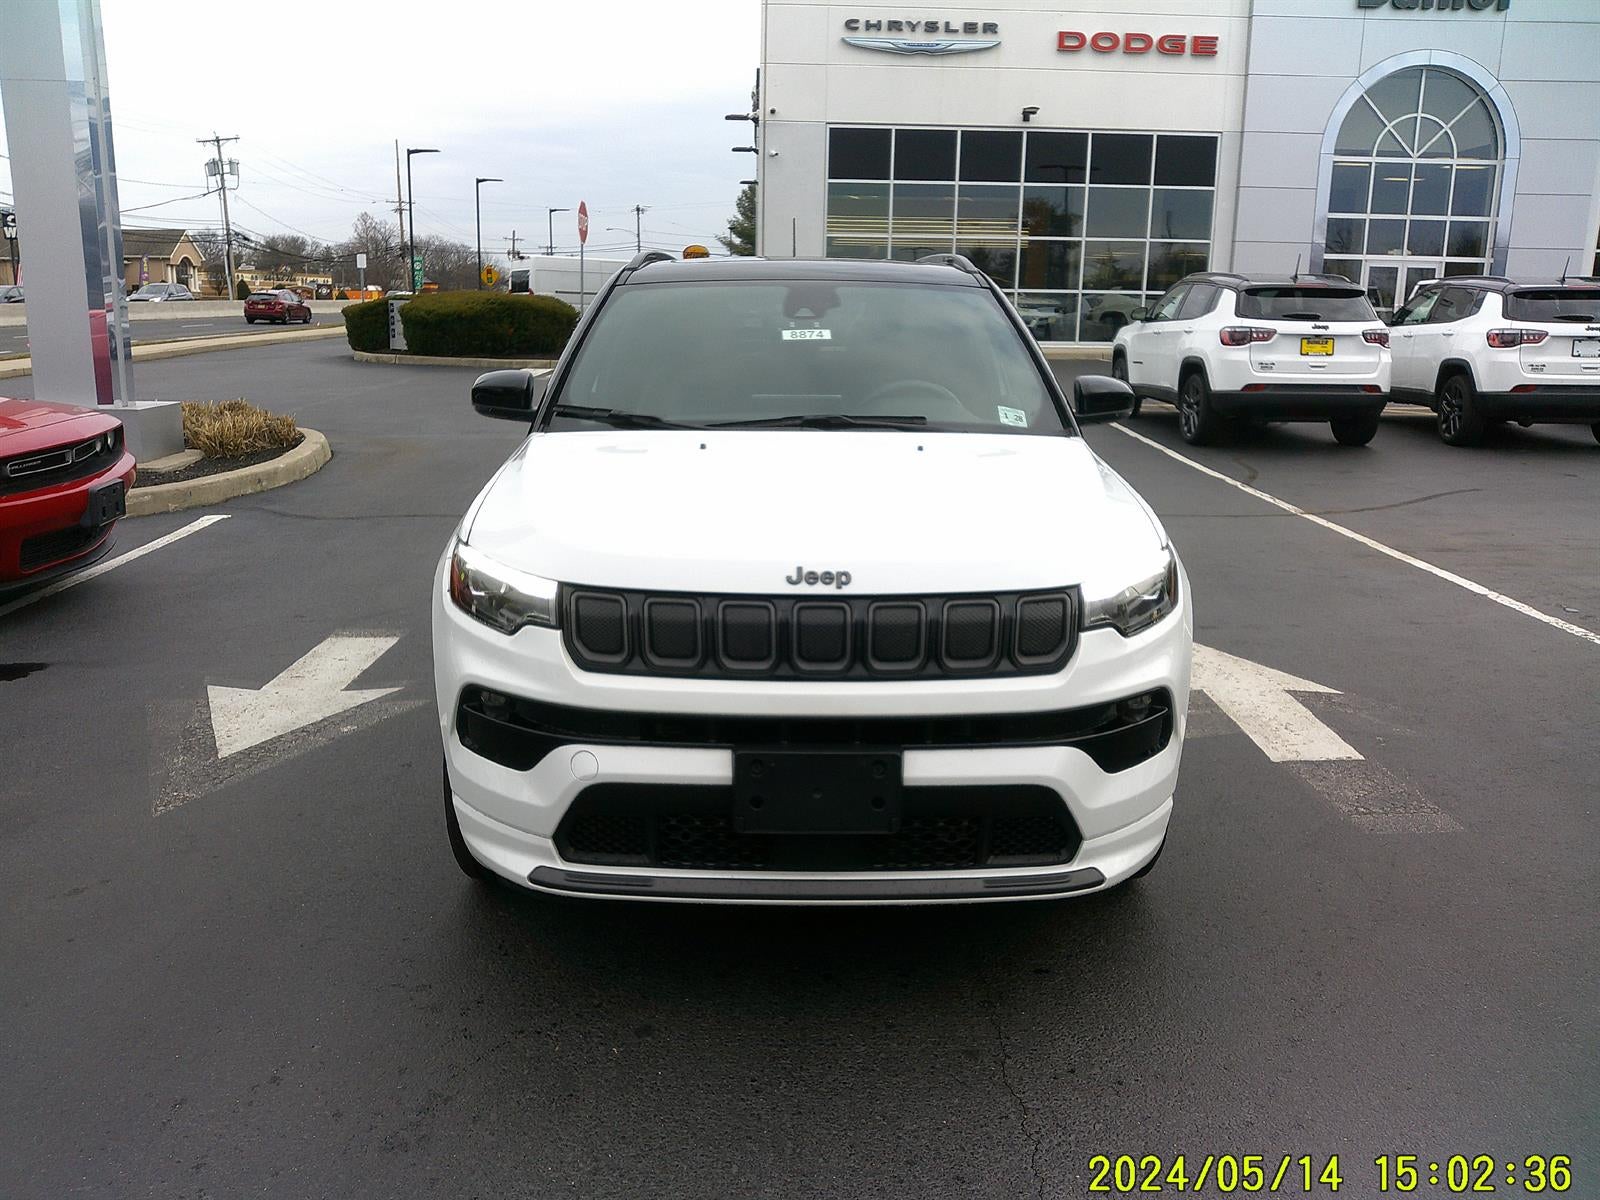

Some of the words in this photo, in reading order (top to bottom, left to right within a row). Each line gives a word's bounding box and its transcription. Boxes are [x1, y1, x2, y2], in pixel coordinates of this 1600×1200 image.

[845, 19, 998, 34] CHRYSLER
[1056, 31, 1219, 56] DODGE
[790, 330, 824, 339] 8874
[1311, 323, 1329, 331] Jeep
[785, 566, 852, 590] Jeep
